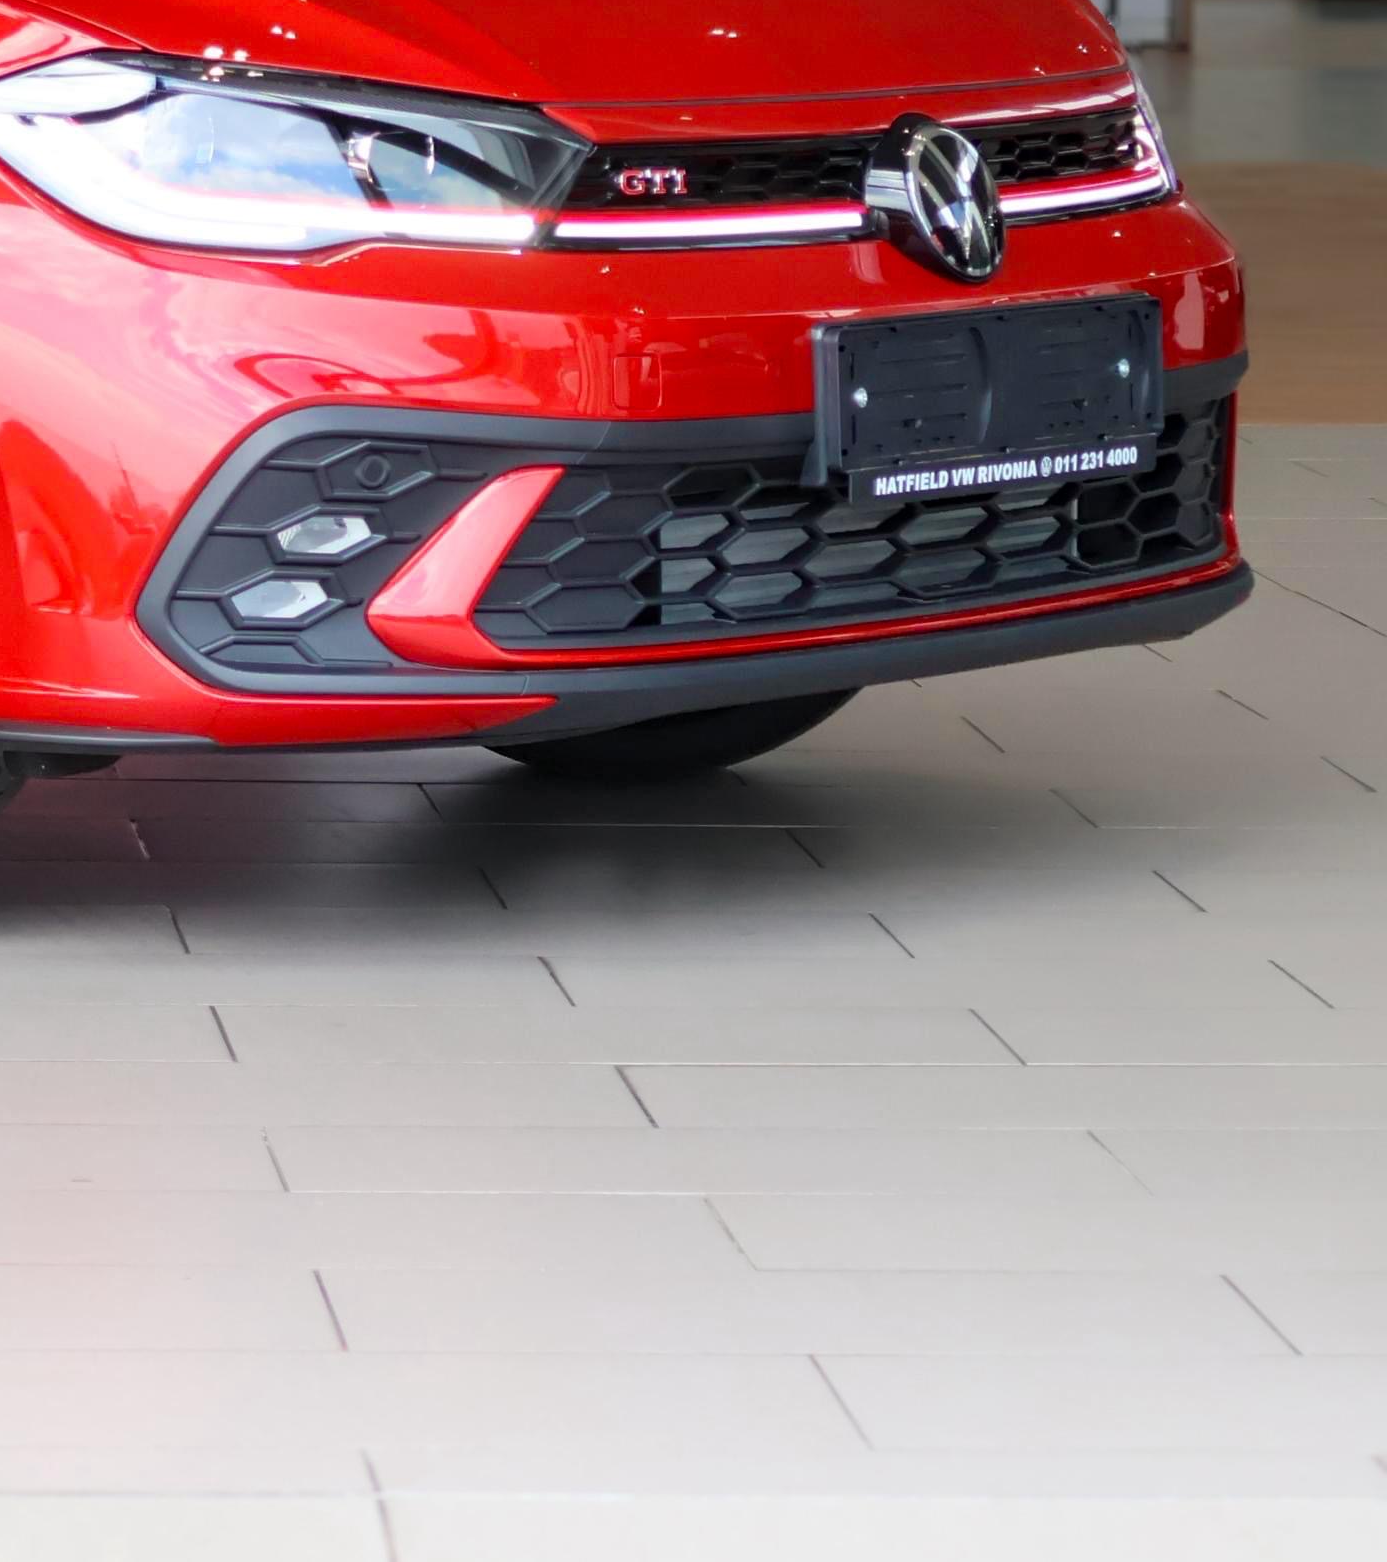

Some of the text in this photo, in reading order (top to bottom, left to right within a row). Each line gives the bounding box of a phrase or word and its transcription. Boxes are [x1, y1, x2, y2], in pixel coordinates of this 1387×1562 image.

[619, 168, 688, 196] GTI
[875, 469, 949, 496] HATFIELD
[951, 466, 976, 487] VW
[977, 459, 1039, 485] RIVONIA
[1054, 454, 1078, 475] 011
[1081, 450, 1104, 471] 231
[1106, 446, 1139, 468] 4000
